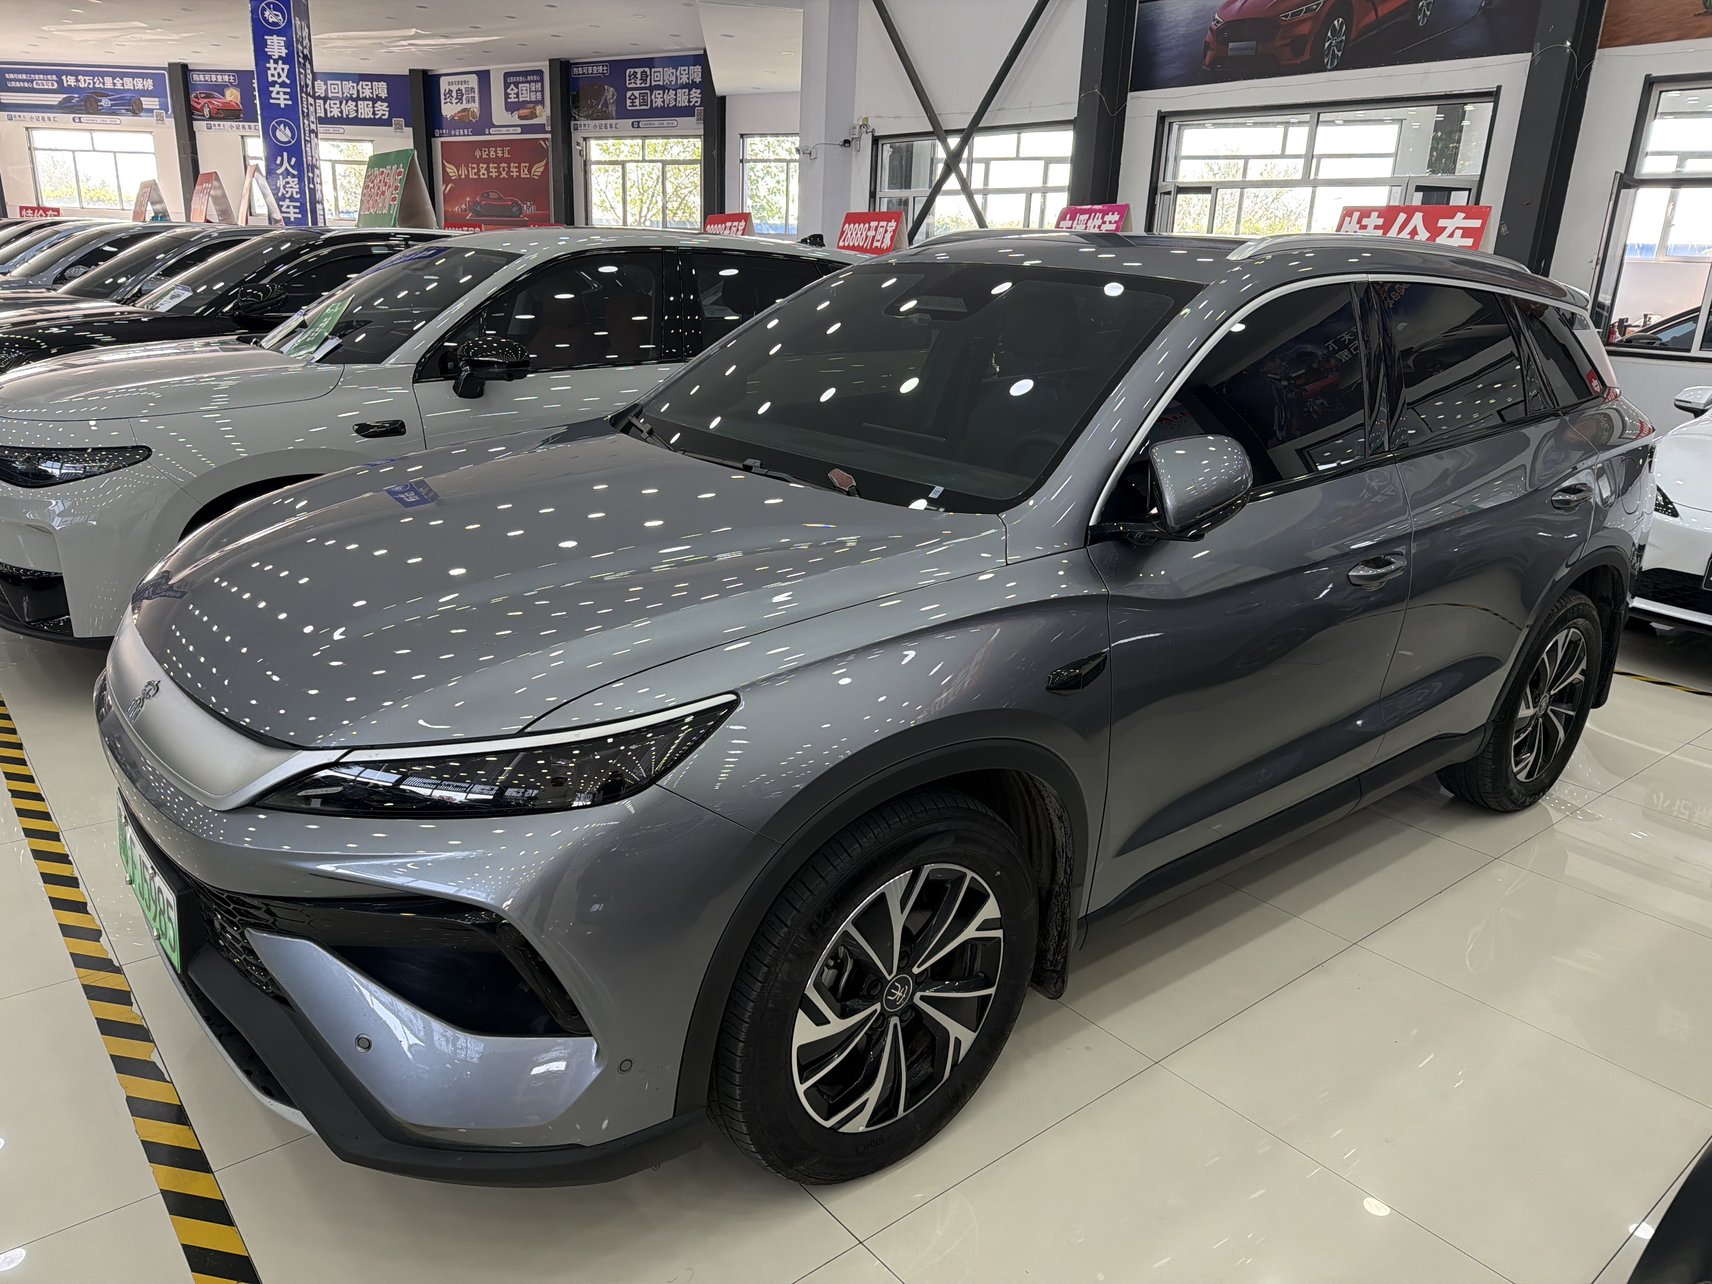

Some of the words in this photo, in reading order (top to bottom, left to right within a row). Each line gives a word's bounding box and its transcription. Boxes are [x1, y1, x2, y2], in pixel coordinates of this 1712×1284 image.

[264, 34, 292, 108] 事故车
[627, 65, 702, 86] 终身回购保障
[443, 88, 464, 105] 终身
[506, 83, 530, 102] 全国
[627, 88, 701, 109] 全国保修服务
[474, 147, 511, 159] 小记名车汇
[459, 162, 531, 179] 小记名车交车区
[275, 152, 302, 222] 火烧车
[838, 219, 897, 250] 28888开回家
[1338, 211, 1483, 248] 特价车
